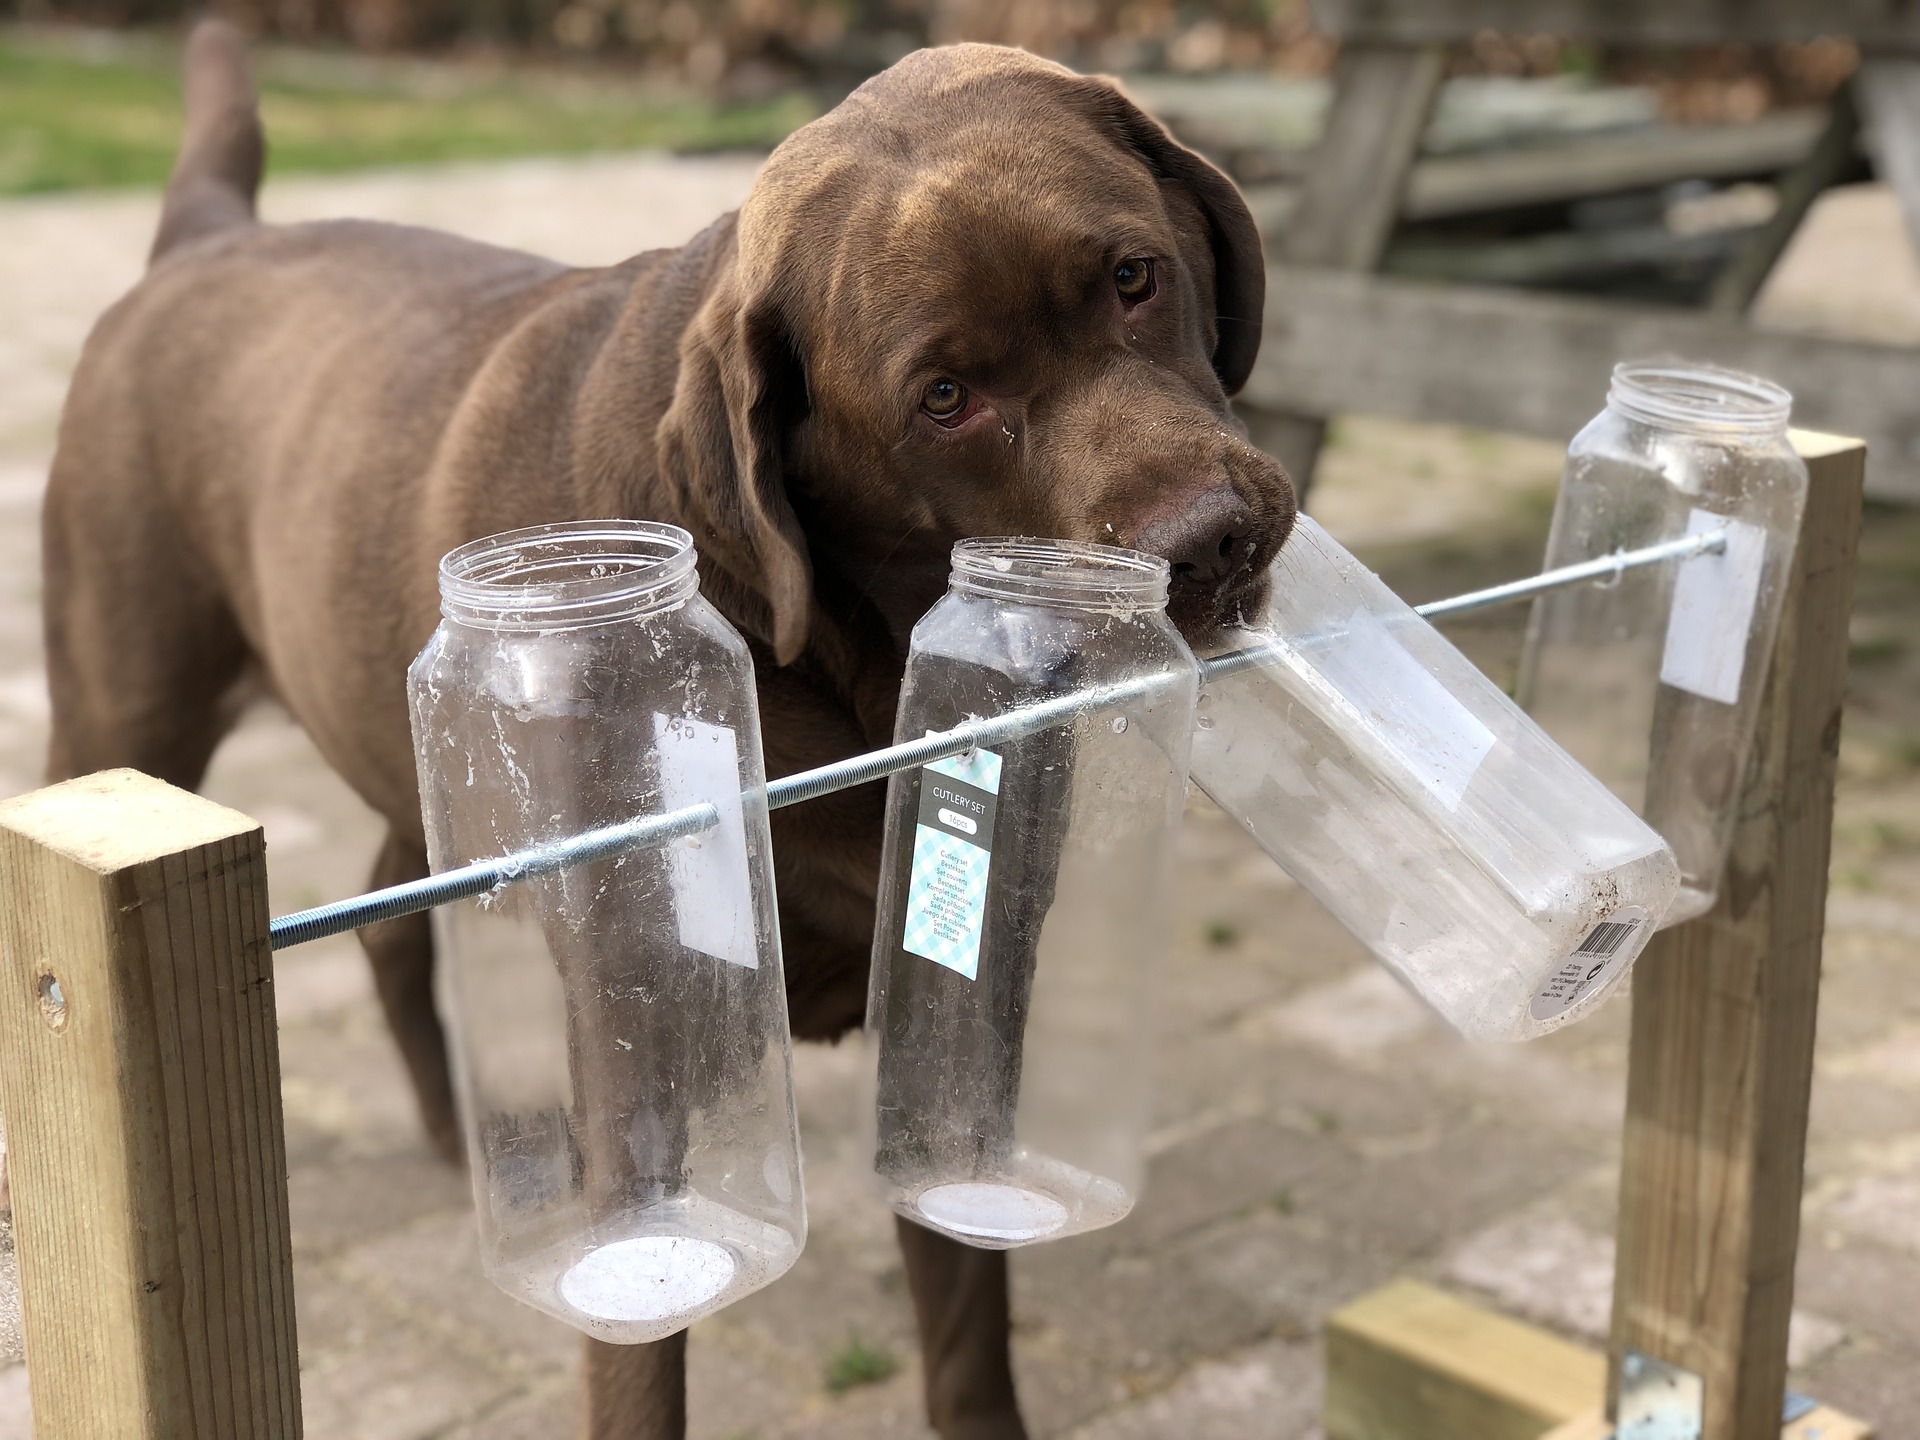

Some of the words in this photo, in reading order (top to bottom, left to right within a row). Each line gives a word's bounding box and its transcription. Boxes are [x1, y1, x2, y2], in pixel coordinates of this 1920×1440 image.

[933, 787, 970, 808] CUTLERY
[971, 801, 986, 815] SET
[949, 814, 968, 829] 16pcs
[940, 850, 960, 864] Cutlery
[960, 859, 968, 867] set
[941, 859, 966, 876] Bestekset
[936, 867, 945, 877] Set
[946, 873, 968, 886] couverts
[926, 882, 949, 896] Komplet
[937, 877, 965, 895] Besteckset
[930, 900, 943, 911] Sada
[932, 893, 946, 904] Sada
[922, 907, 939, 919] Juego
[948, 919, 971, 933] cubiertos
[933, 919, 942, 929] Set
[943, 923, 960, 936] Posate
